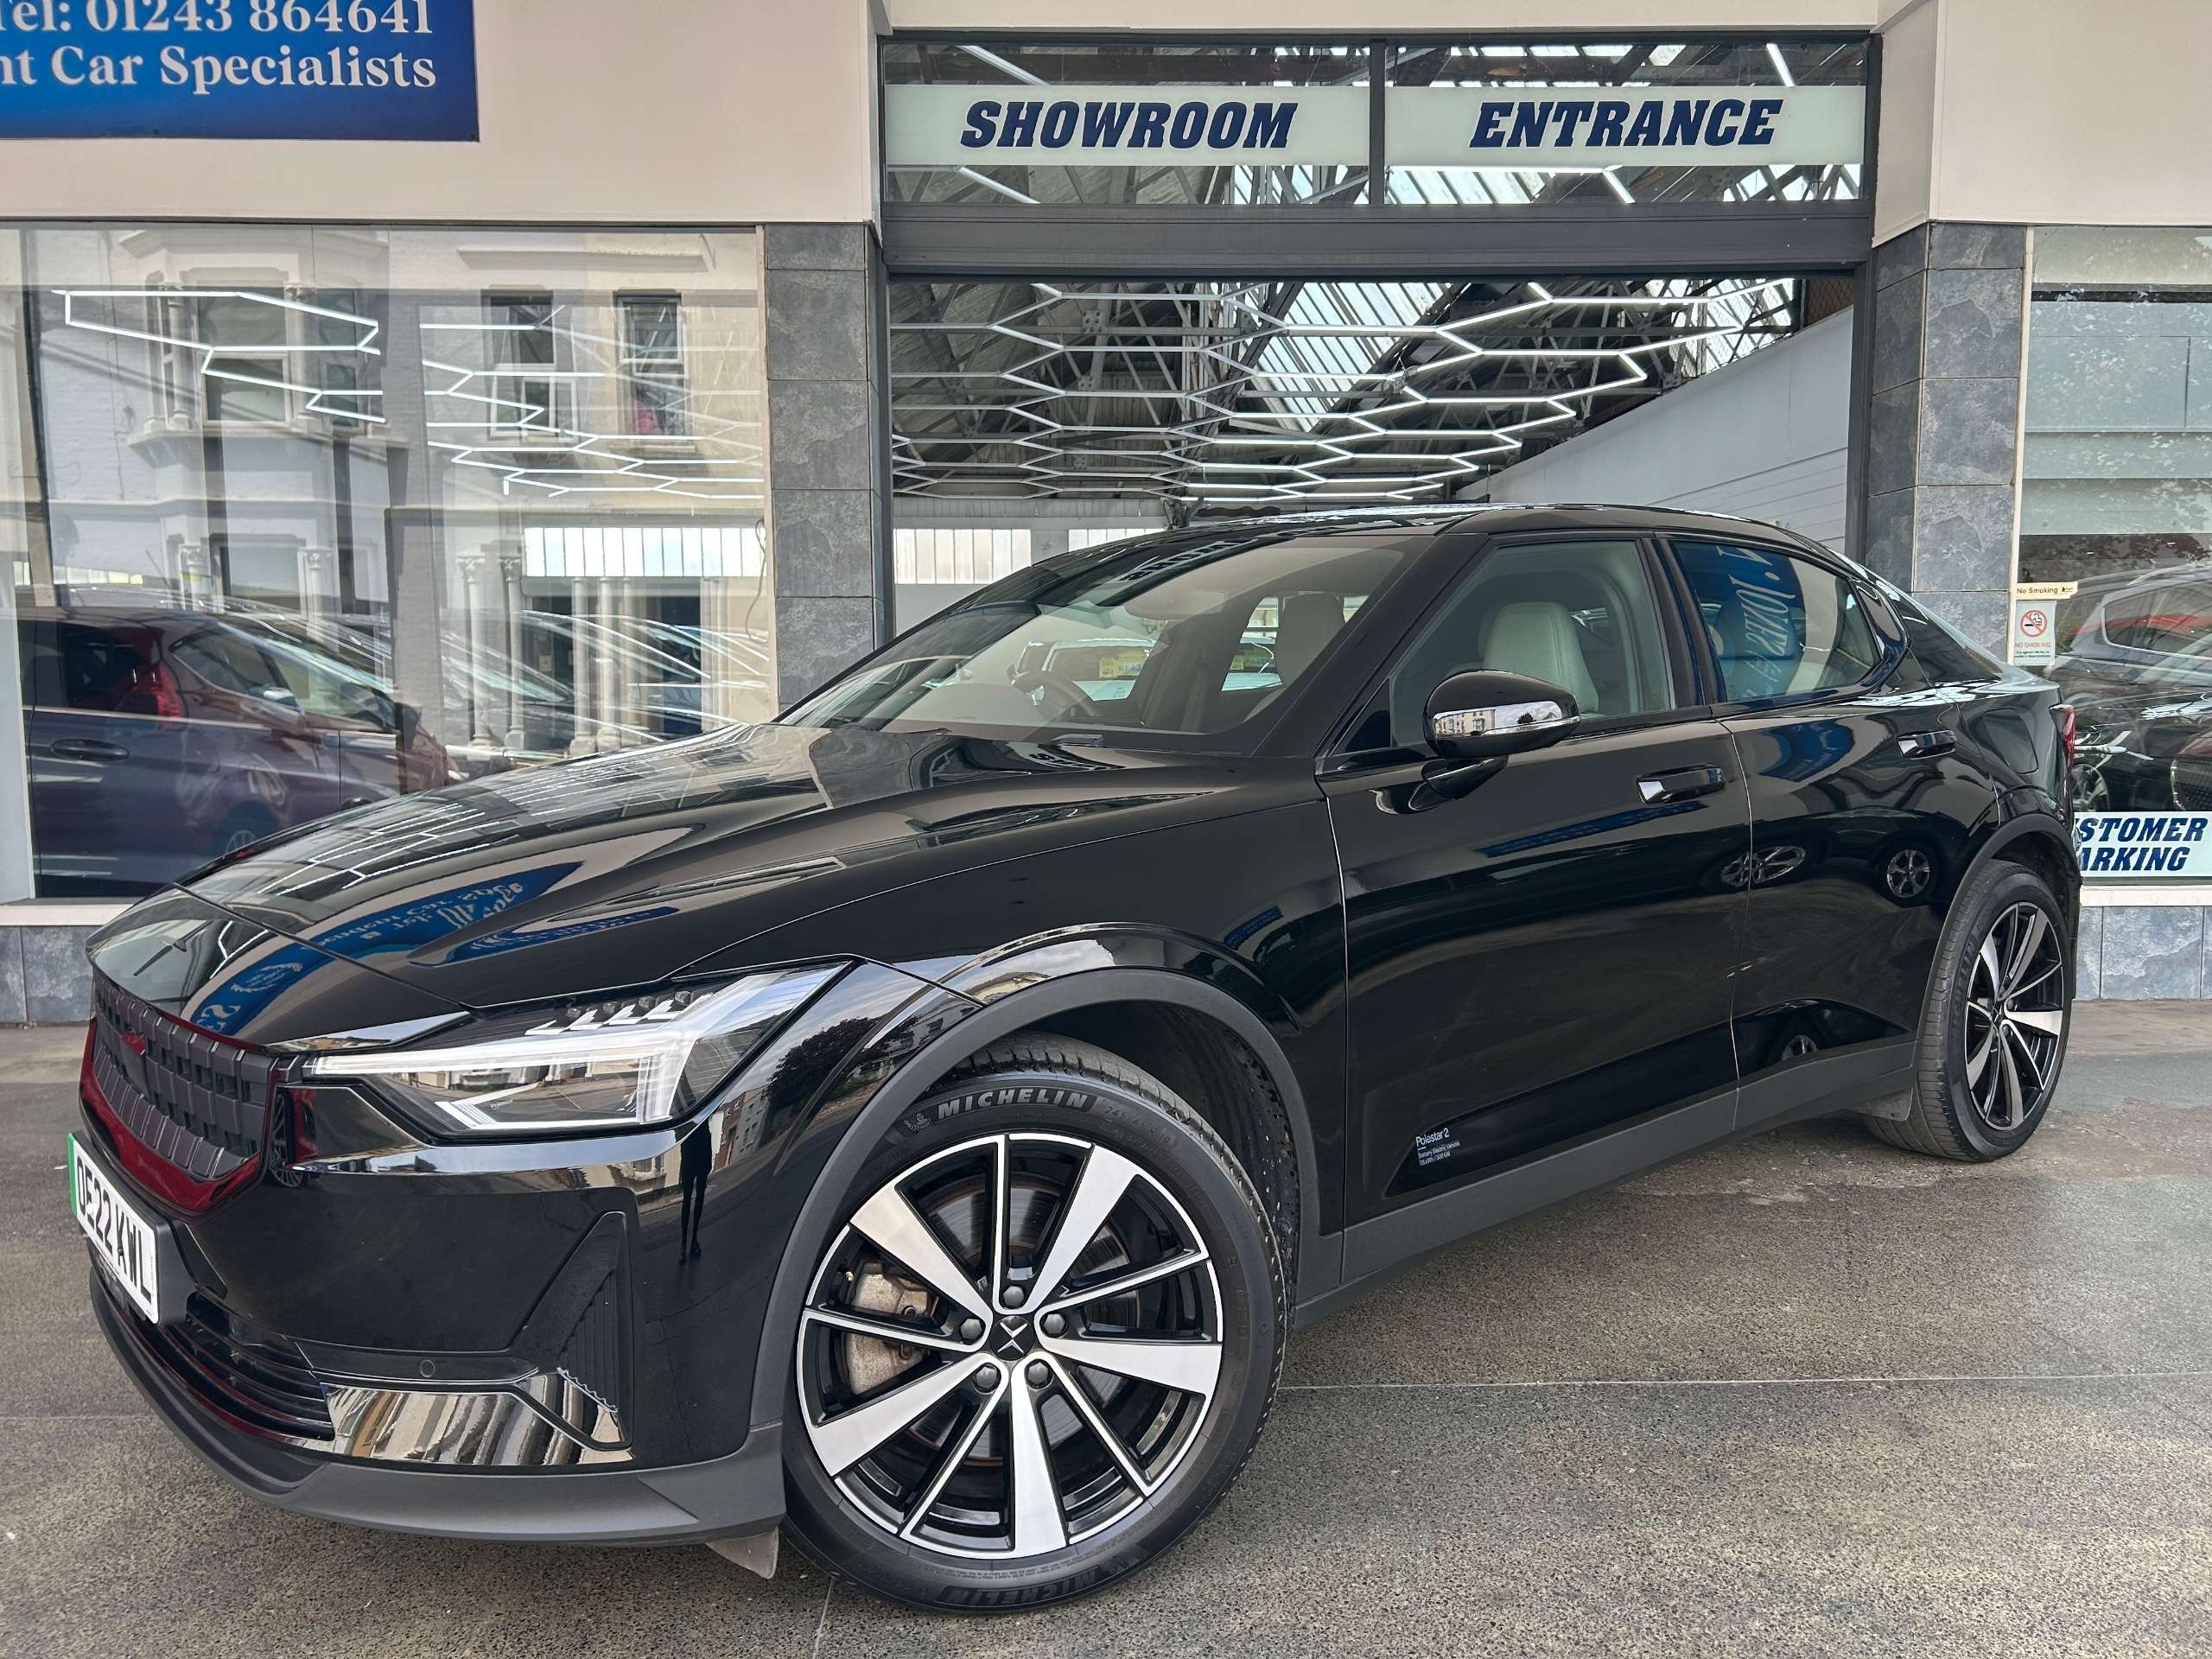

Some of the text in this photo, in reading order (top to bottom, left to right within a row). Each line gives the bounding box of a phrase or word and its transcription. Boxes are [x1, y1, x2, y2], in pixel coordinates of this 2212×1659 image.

[86, 0, 232, 32] 01243
[250, 0, 433, 33] 864641
[52, 46, 143, 85] Car
[161, 46, 436, 94] Specialists
[960, 100, 1298, 149] SHOWROOM
[1469, 99, 1783, 148] ENTRANCE
[2075, 817, 2209, 842] STOMER
[2081, 847, 2190, 871] ARKING
[938, 1086, 1088, 1121] MICHELIN
[1415, 1127, 1450, 1147] Polestar 2
